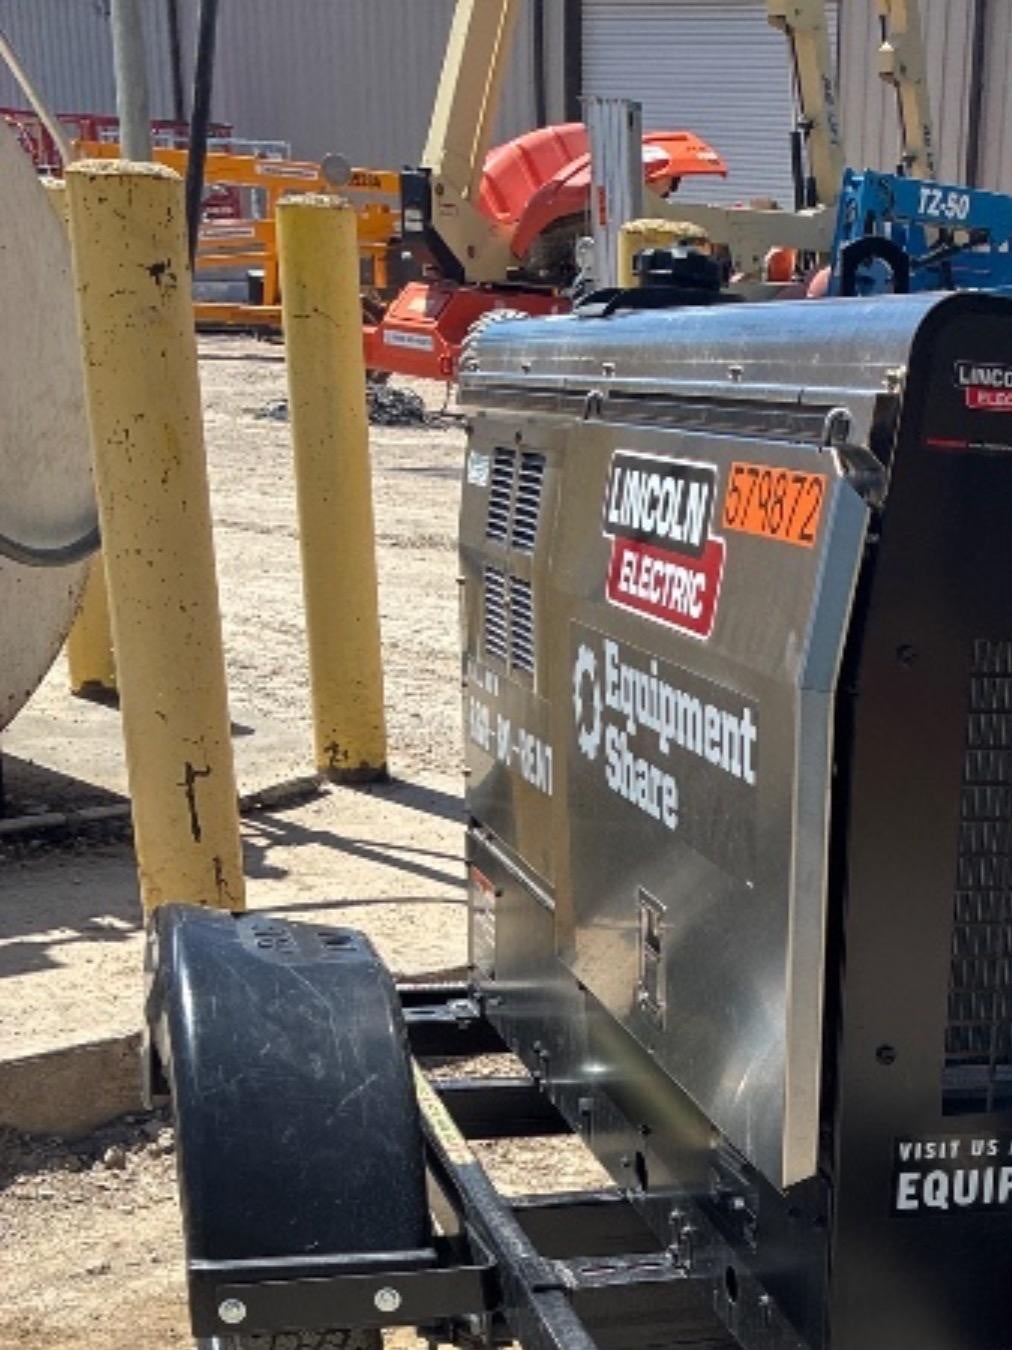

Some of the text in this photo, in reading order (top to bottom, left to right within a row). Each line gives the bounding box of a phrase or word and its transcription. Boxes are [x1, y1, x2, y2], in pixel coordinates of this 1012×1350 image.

[918, 188, 970, 219] TZ-50
[608, 467, 710, 546] LINCOLN
[725, 465, 824, 541] 579872
[619, 551, 706, 619] ELECTRIC
[603, 640, 758, 786] Equipment
[604, 729, 679, 831] Share
[899, 1140, 960, 1161] VISIT
[971, 1139, 1000, 1157] US
